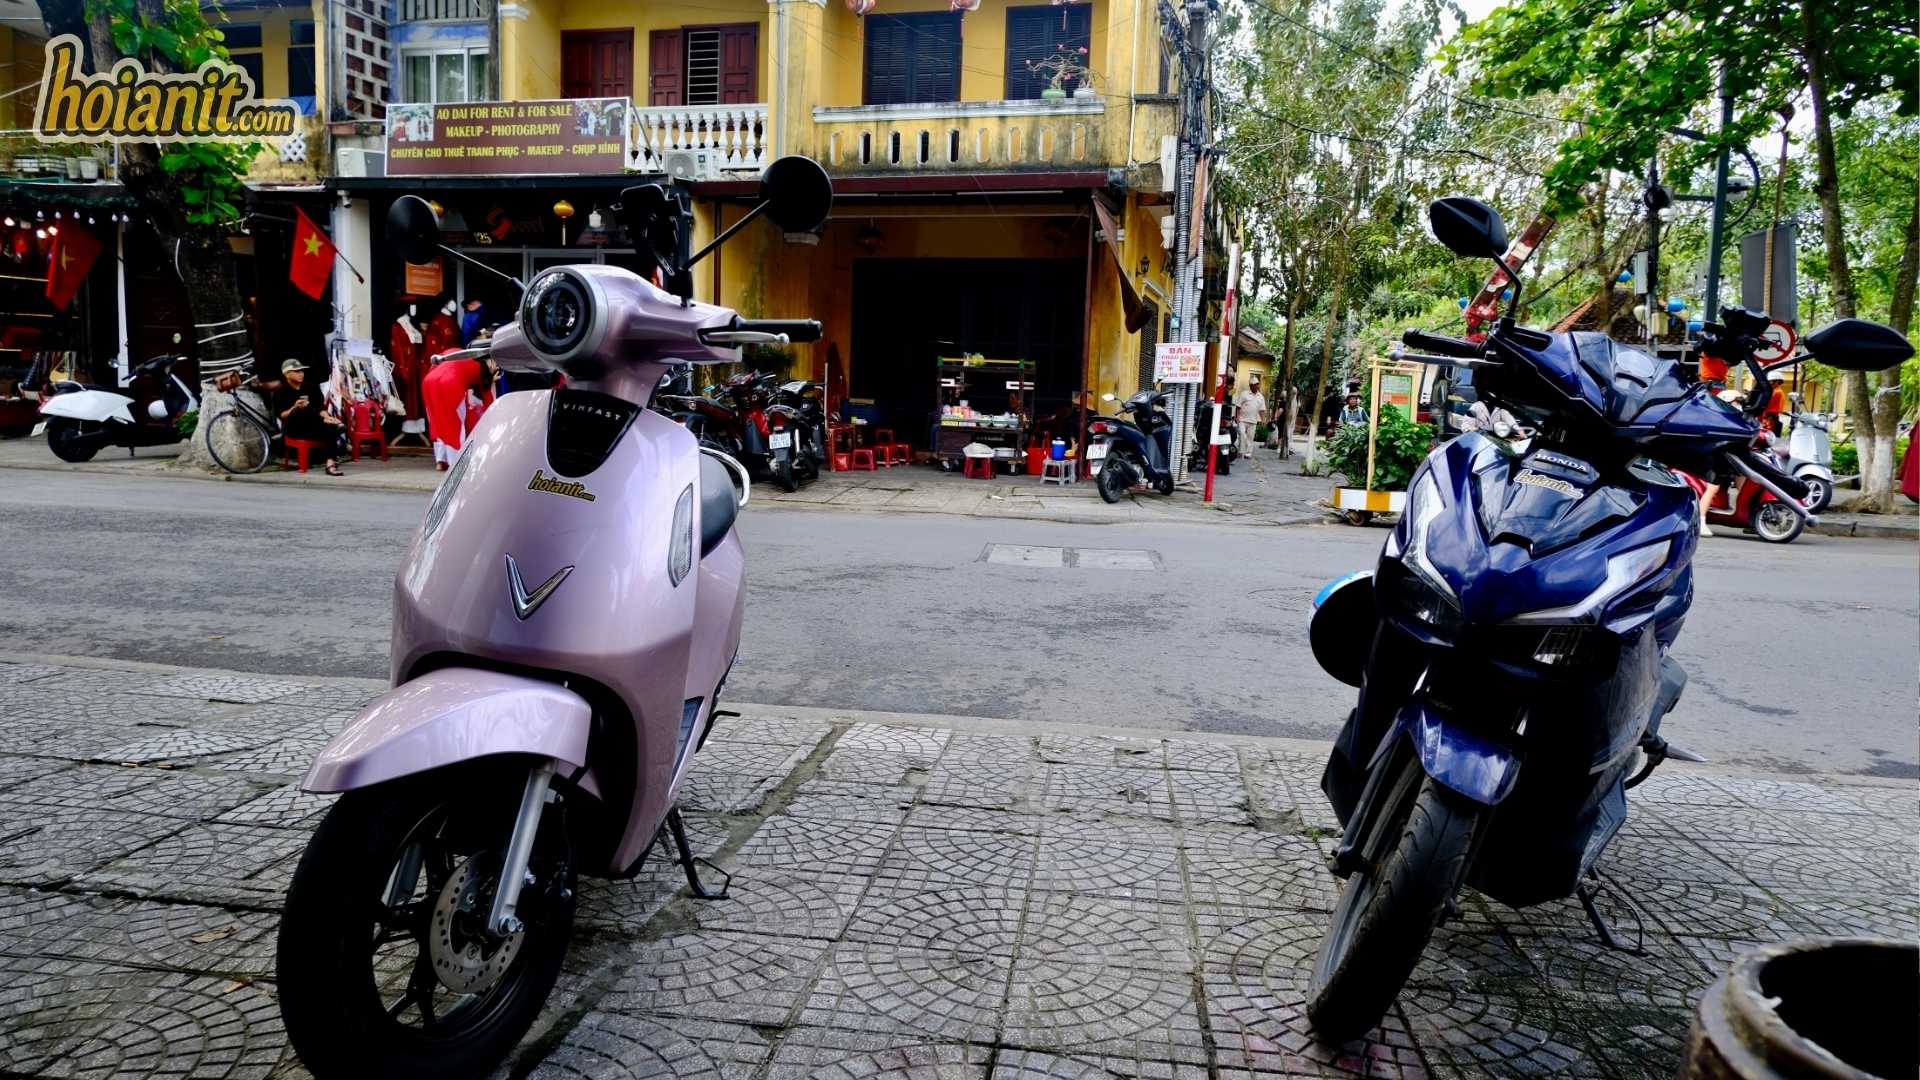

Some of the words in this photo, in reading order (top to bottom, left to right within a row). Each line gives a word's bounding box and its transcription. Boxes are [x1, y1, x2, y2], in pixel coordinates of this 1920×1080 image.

[436, 108, 450, 120] AO
[451, 108, 468, 119] DAI
[470, 107, 489, 119] FOR
[491, 106, 514, 119] RENT
[518, 106, 525, 117] &
[527, 105, 547, 117] FOR
[549, 104, 573, 117] SALE
[445, 126, 484, 137] MAKEUP
[491, 123, 561, 137] PHOTOGRAPHY
[391, 146, 424, 158] CHUYÊN
[424, 147, 442, 158] CHO
[444, 145, 465, 157] THUÊ
[467, 146, 494, 157] TRANG
[495, 146, 520, 158] PHỤC
[527, 145, 565, 156] MAKEUP
[572, 143, 597, 156] CHỤP
[598, 141, 620, 154] HÌNH
[562, 403, 621, 420] VINFAST
[1535, 453, 1587, 472] HONDA
[528, 469, 596, 502] hoianit
